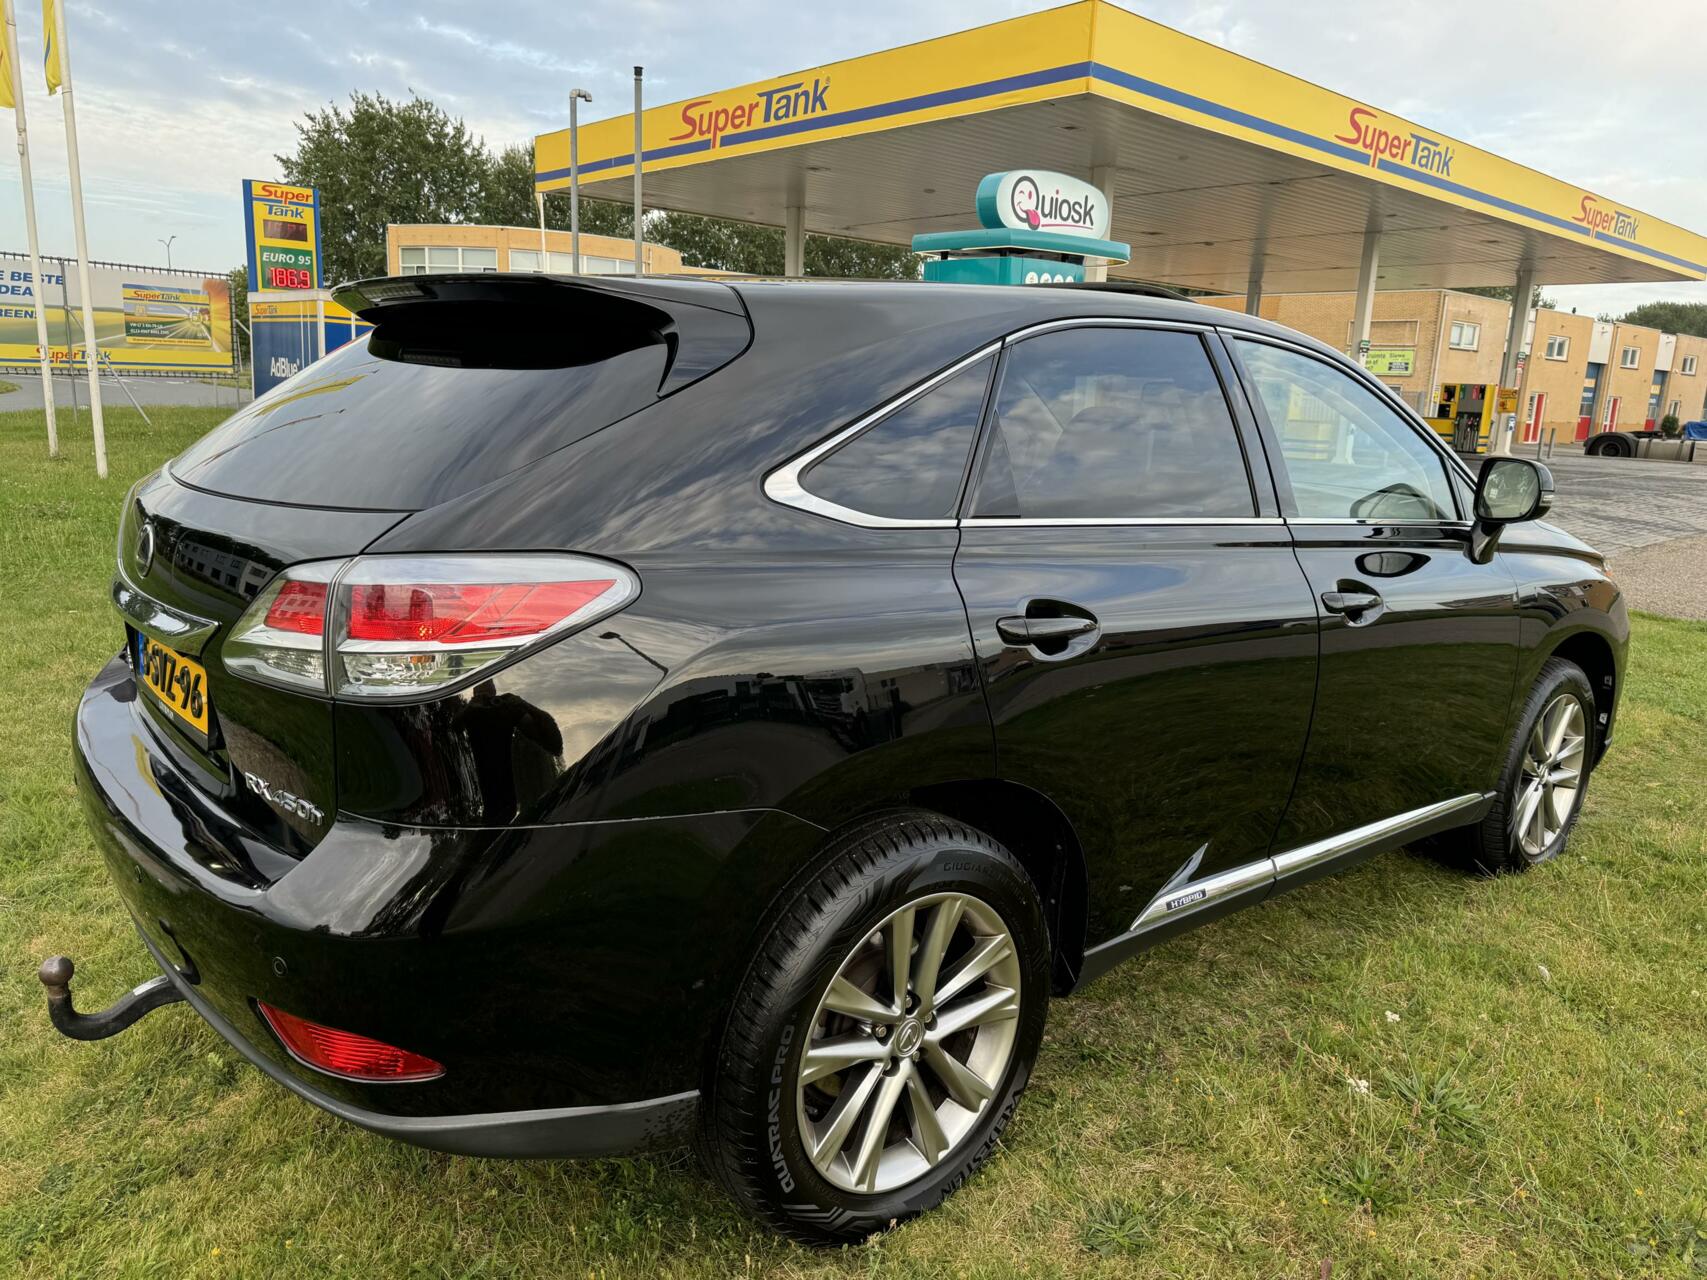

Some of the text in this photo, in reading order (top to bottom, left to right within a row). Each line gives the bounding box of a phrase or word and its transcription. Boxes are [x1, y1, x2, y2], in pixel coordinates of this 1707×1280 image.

[668, 77, 829, 149] SuperTank
[1333, 107, 1455, 177] SuperTank
[253, 184, 313, 205] Super
[263, 203, 305, 219] Tank
[1010, 175, 1095, 230] Quiosk
[1571, 195, 1640, 241] SuperTank
[262, 252, 312, 265] EURO 95
[1171, 889, 1203, 909] HYBRID
[767, 1025, 796, 1194] QUATRAC PRO
